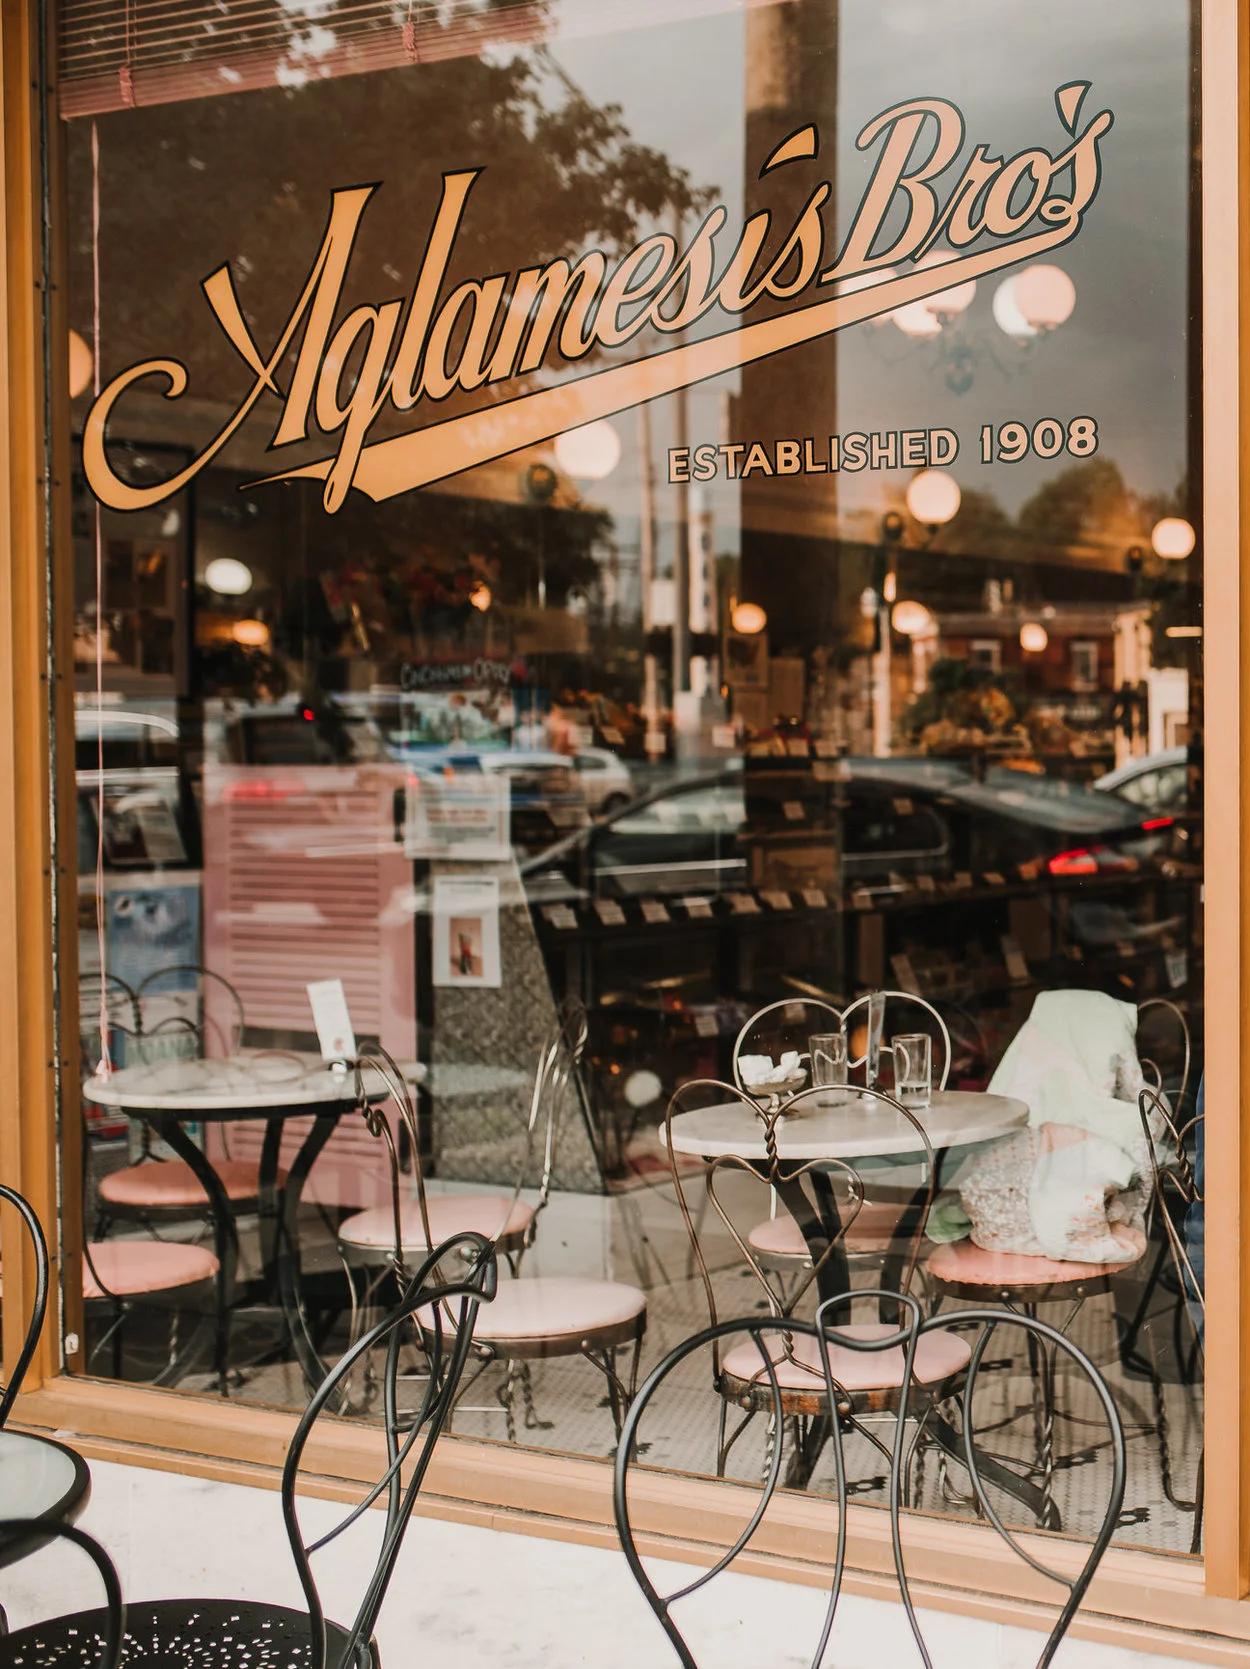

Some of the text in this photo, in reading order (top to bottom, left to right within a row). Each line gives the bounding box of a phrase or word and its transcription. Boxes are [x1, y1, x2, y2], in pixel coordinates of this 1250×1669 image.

[82, 79, 1115, 514] Aglamesis Bro's
[667, 416, 1099, 484] ESTABLISHED 1908
